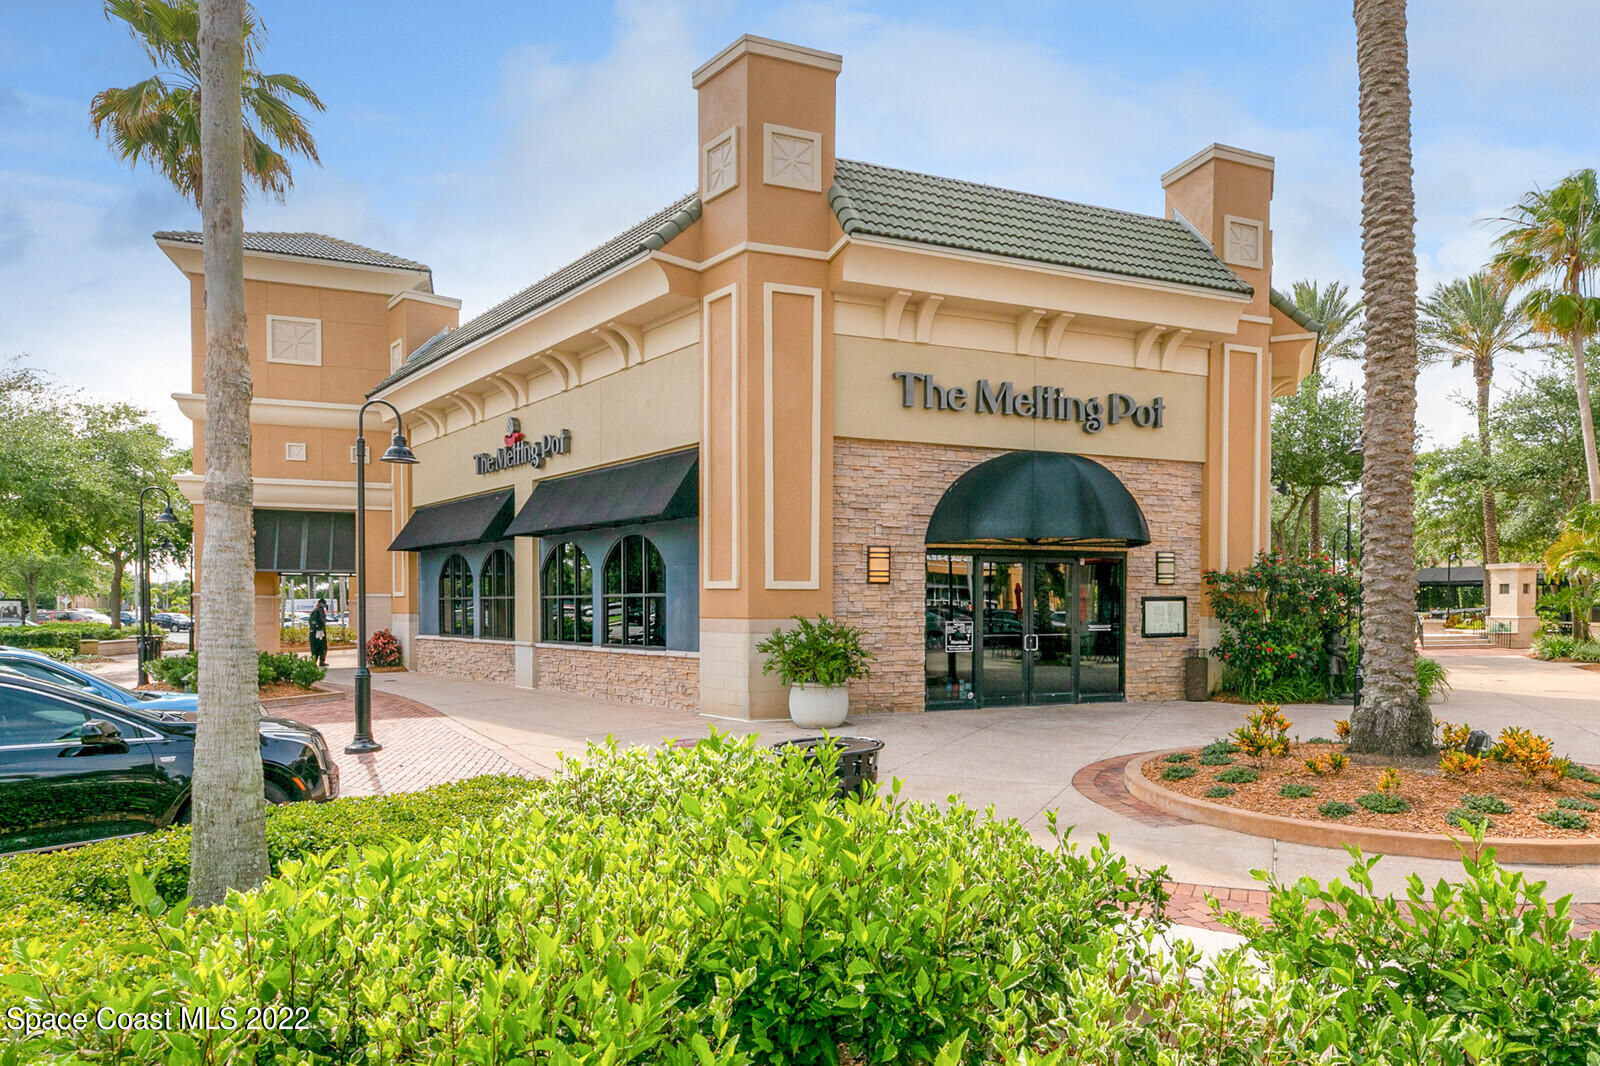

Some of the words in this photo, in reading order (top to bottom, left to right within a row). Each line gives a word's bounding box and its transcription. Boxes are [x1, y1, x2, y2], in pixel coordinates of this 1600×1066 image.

[892, 371, 968, 411] The
[974, 378, 1104, 434] Melting
[1107, 392, 1166, 428] Pot
[473, 452, 495, 475] The
[495, 440, 544, 469] Melting
[541, 428, 570, 458] Pot
